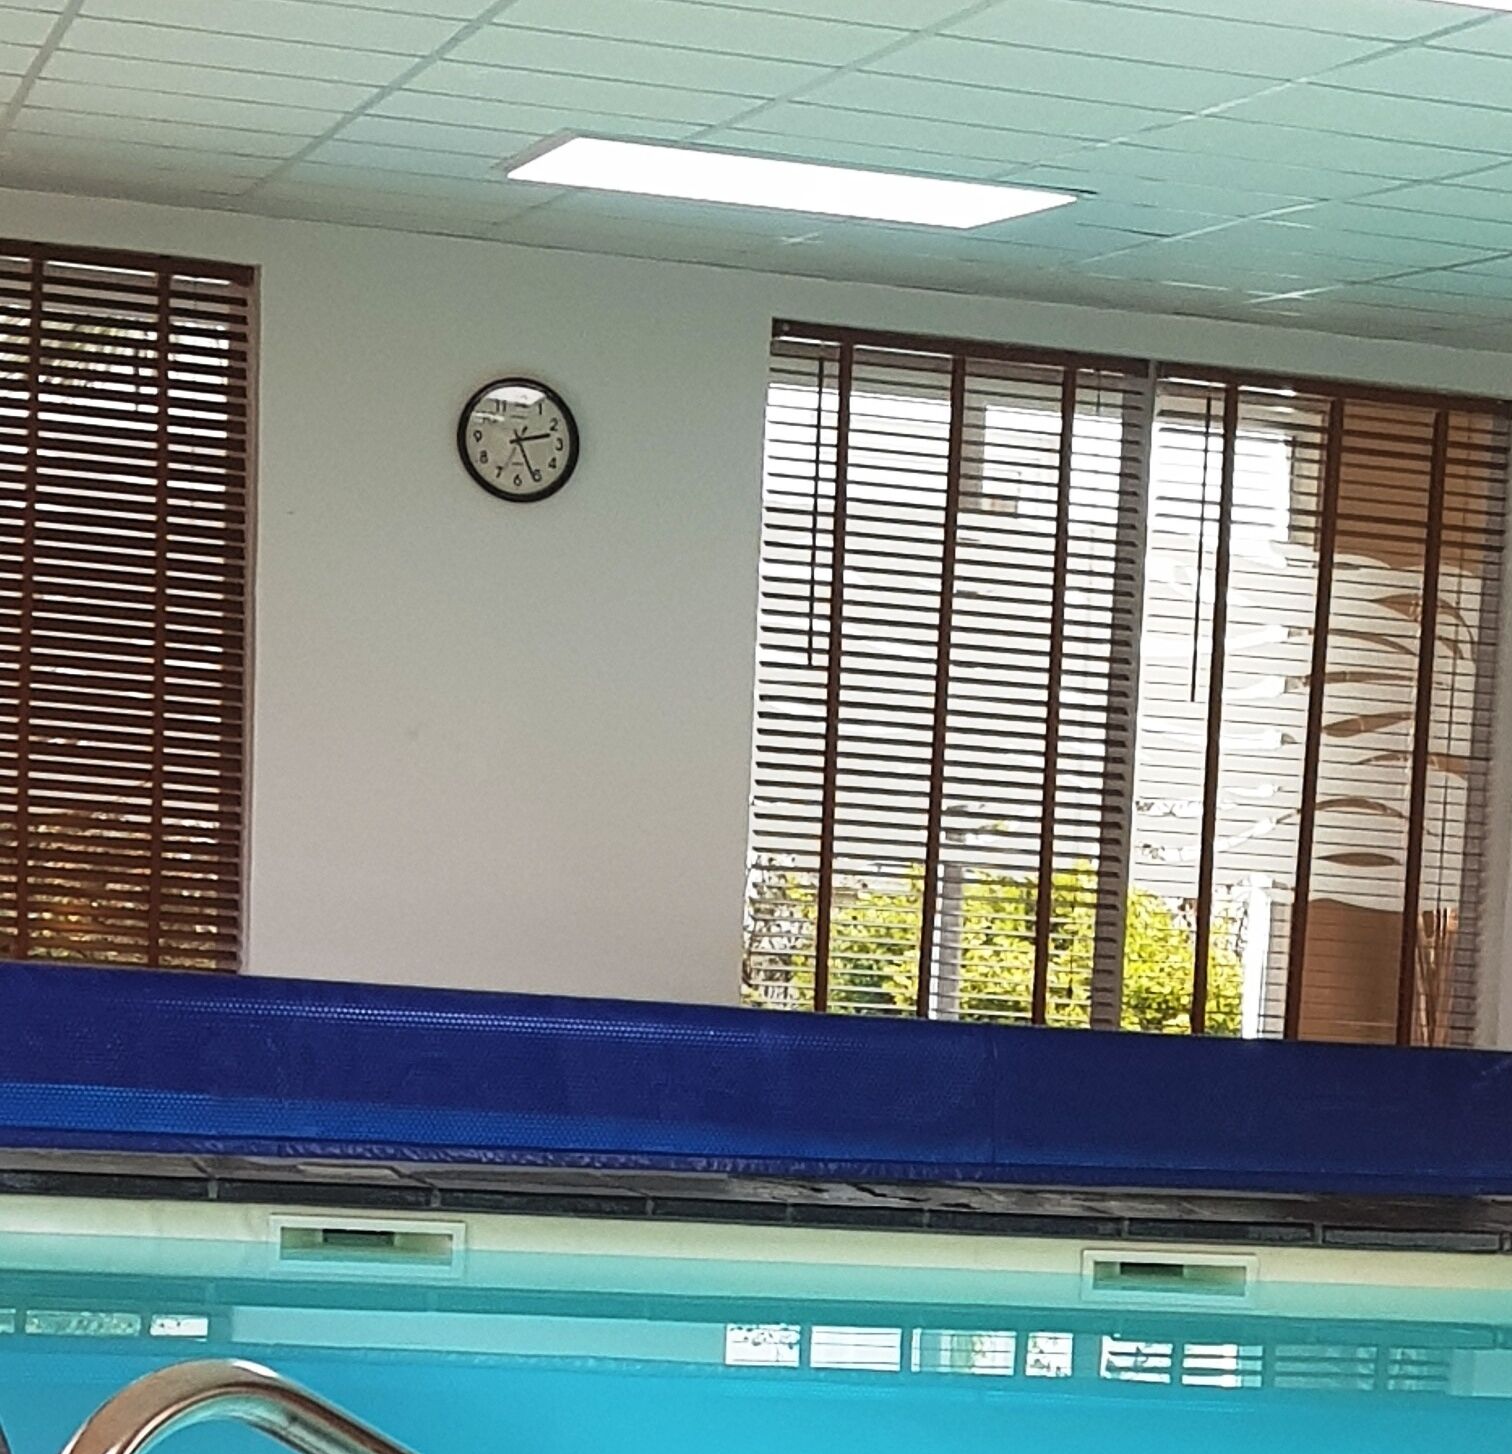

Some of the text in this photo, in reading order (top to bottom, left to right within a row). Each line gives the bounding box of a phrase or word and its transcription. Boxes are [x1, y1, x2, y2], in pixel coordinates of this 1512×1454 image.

[550, 418, 558, 432] 2
[473, 430, 482, 442] 9
[480, 450, 488, 464] 8
[548, 457, 557, 469] 4
[496, 465, 504, 478] 7
[513, 474, 522, 486] 6
